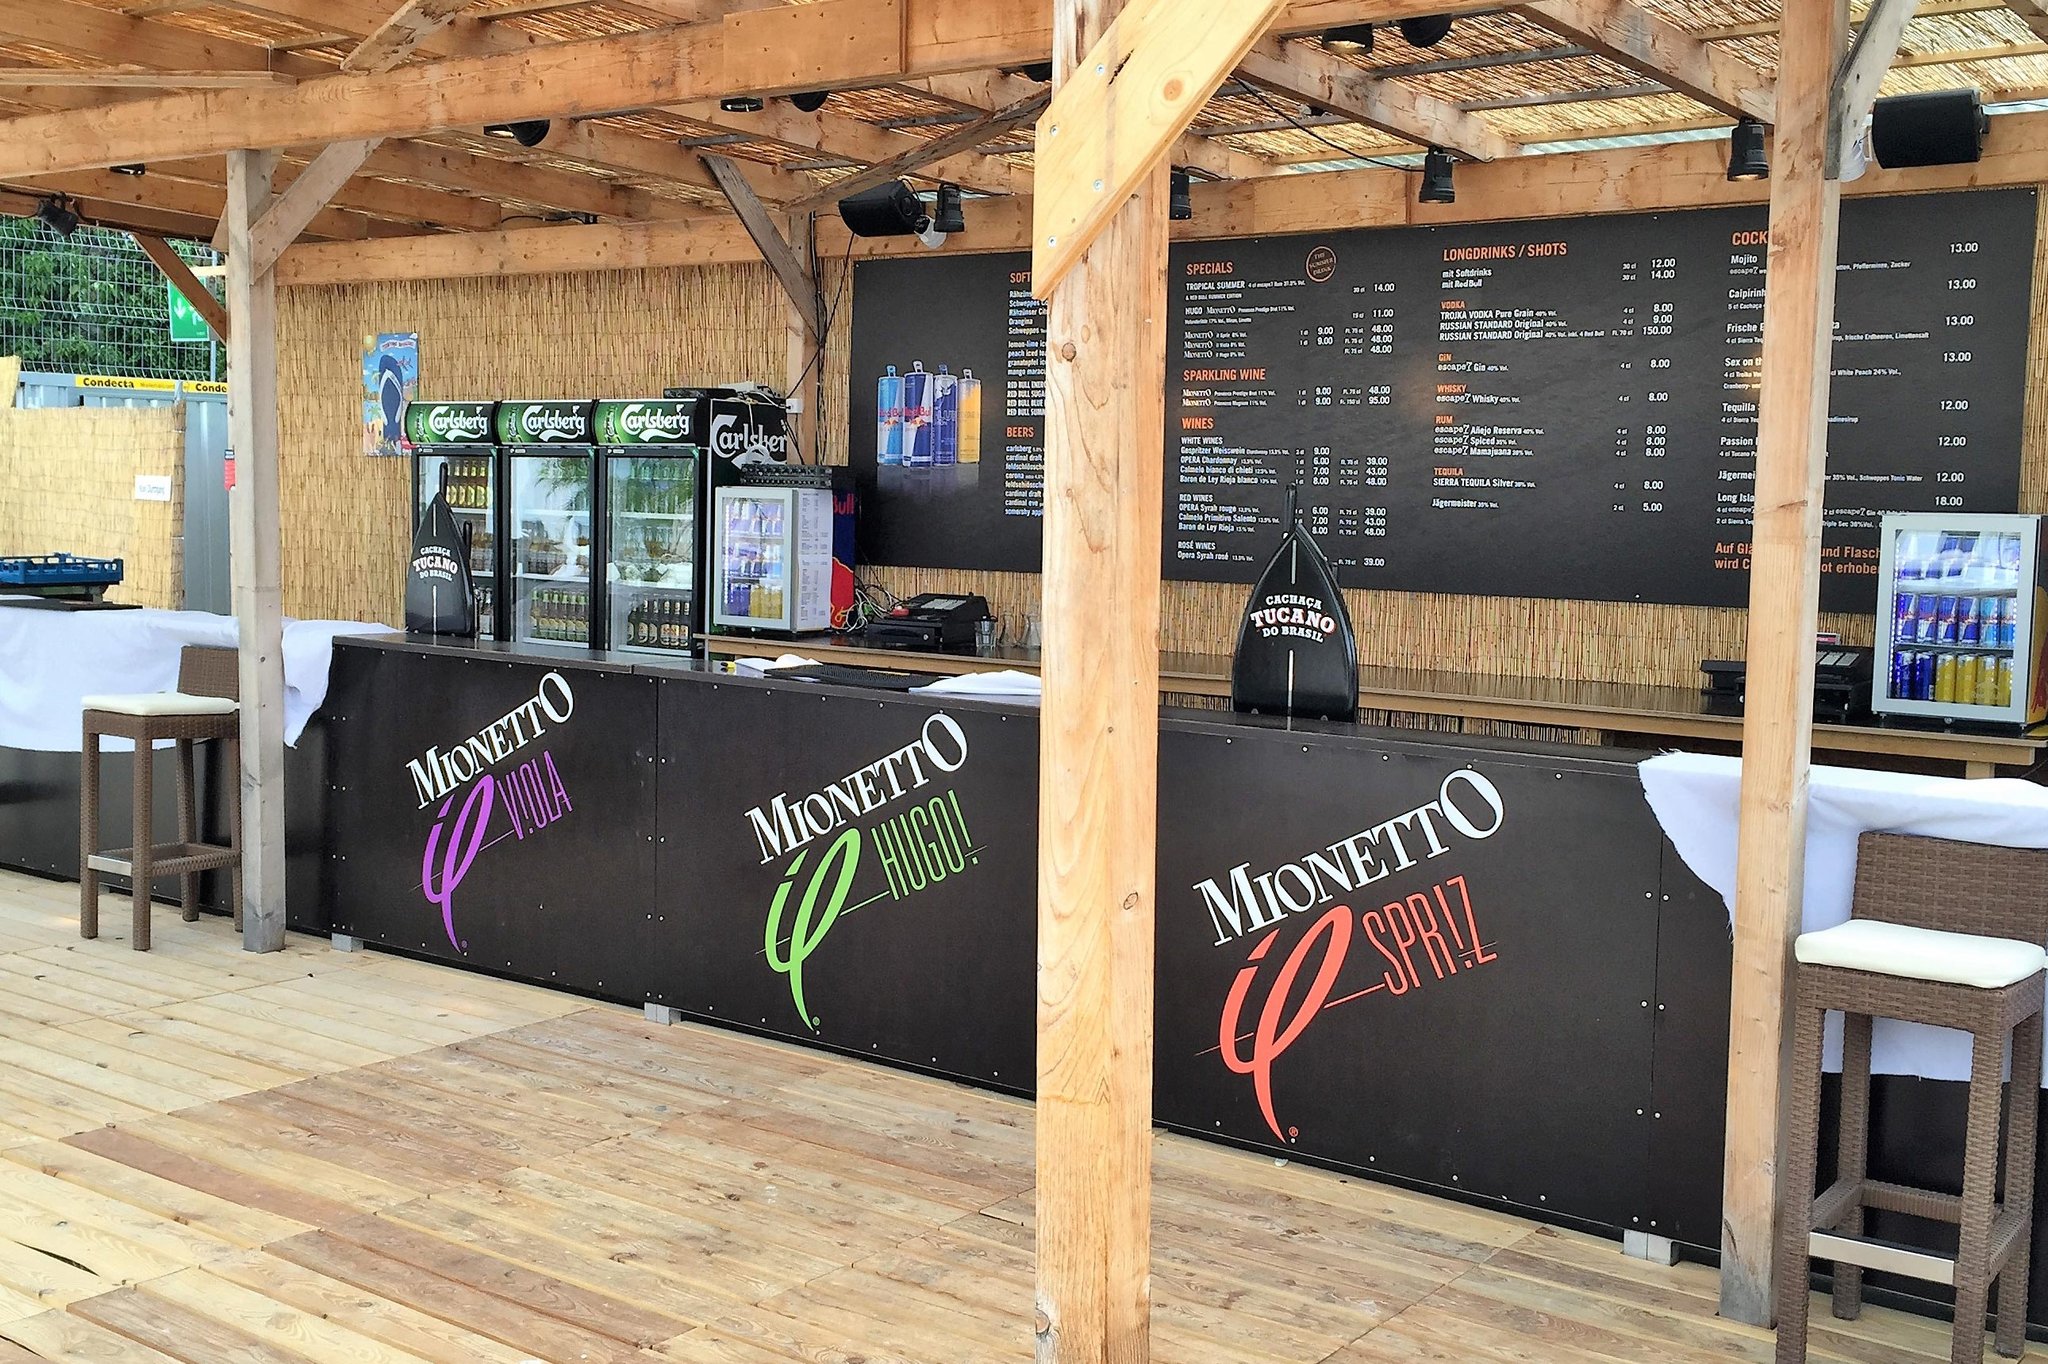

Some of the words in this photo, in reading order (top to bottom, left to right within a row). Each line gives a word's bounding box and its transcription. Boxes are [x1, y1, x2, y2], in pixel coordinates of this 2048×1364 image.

[1732, 232, 1768, 246] COCK
[1443, 245, 1516, 262] LONGDRINKS
[1527, 243, 1567, 257] SHOTS
[1731, 255, 1757, 265] Mojito
[1949, 242, 1979, 253] 13.00
[1186, 262, 1233, 275] SPECIALS
[1442, 269, 1454, 278] mit
[1455, 268, 1492, 278] Softdrinks
[1651, 258, 1676, 268] 12.00
[1010, 272, 1031, 283] SOFT
[1442, 280, 1453, 289] mit
[1651, 270, 1675, 279] 14.00
[1186, 282, 1215, 291] TROPICAL
[1217, 280, 1245, 289] SUMMER
[1373, 283, 1395, 292] 14.00
[1947, 279, 1976, 290] 13.00
[1441, 301, 1465, 309] VODKA
[1185, 307, 1202, 315] HUGO
[1373, 309, 1393, 318] 11.00
[1440, 311, 1467, 320] TROJKA
[1469, 310, 1493, 319] VODKA
[1495, 309, 1512, 318] Pure
[1514, 309, 1534, 317] Grain
[1653, 303, 1673, 313] 8.00
[1440, 321, 1472, 330] RUSSIAN
[1474, 320, 1512, 329] STANDARD
[1515, 319, 1543, 330] Original
[1653, 315, 1672, 324] 9.00
[1727, 323, 1757, 333] Frische
[1945, 315, 1974, 326] 13.00
[1318, 327, 1333, 335] 9.00
[1371, 324, 1393, 333] 48.00
[1439, 331, 1471, 341] RUSSIAN
[1473, 331, 1512, 340] STANDARD
[1514, 330, 1543, 340] Original
[1642, 326, 1672, 335] 150.00
[1317, 336, 1333, 345] 9.00
[1371, 334, 1393, 343] 48.00
[1370, 345, 1392, 354] 48.00
[1474, 363, 1485, 371] Gin
[1650, 359, 1670, 368] 8.00
[1725, 358, 1741, 367] Sex
[1943, 352, 1971, 362] 13.00
[1183, 369, 1236, 382] SPARKLING
[1239, 368, 1266, 380] WINE
[83, 377, 134, 388] Condecta
[1315, 386, 1332, 395] 9.00
[1368, 386, 1391, 395] 48.00
[1437, 384, 1467, 393] WHISKY
[1315, 396, 1331, 405] 9.00
[1368, 396, 1390, 405] 95.00
[1472, 394, 1498, 405] Whisky
[1648, 392, 1668, 402] 8.00
[1722, 403, 1755, 414] Tequilla
[1940, 401, 1969, 411] 12.00
[429, 406, 488, 441] Carlsberg
[522, 405, 585, 441] Carlsberg
[620, 404, 690, 442] Carlsberg
[1182, 418, 1213, 430] WINES
[1435, 416, 1453, 424] RUM
[1007, 427, 1034, 437] BEERS
[1646, 425, 1667, 435] 8.00
[1181, 437, 1201, 445] WHITE
[1202, 437, 1223, 445] WINES
[1470, 436, 1495, 446] Spiced
[1646, 437, 1666, 446] 8.00
[1720, 436, 1753, 446] Passion
[1938, 437, 1966, 447] 12.00
[1314, 447, 1329, 455] 9.00
[1646, 448, 1665, 457] 8.00
[1313, 457, 1329, 466] 6.00
[1366, 457, 1388, 466] 39.00
[1313, 467, 1329, 476] 7.00
[1366, 467, 1387, 476] 43.00
[1434, 468, 1464, 477] TEQUILA
[1312, 477, 1329, 486] 8.00
[1365, 477, 1387, 486] 48.00
[1936, 473, 1964, 482] 12.00
[1433, 478, 1459, 487] SIERRA
[1461, 478, 1491, 488] TEQUILA
[1492, 479, 1514, 488] Silver
[1644, 481, 1664, 490] 8.00
[1179, 494, 1191, 502] RED
[1193, 494, 1213, 502] WINES
[1718, 493, 1737, 504] Long
[1935, 496, 1963, 506] 18.00
[1179, 504, 1198, 512] OPERA
[1312, 506, 1328, 515] 6.00
[1365, 507, 1386, 516] 39.00
[1432, 499, 1477, 510] Jägermeister
[1643, 503, 1663, 512] 5.00
[1312, 516, 1328, 525] 7.00
[1364, 517, 1386, 526] 43.00
[1312, 526, 1328, 535] 8.00
[1364, 528, 1385, 536] 48.00
[1195, 542, 1216, 550] WINES
[1715, 543, 1734, 554] Auf
[412, 556, 458, 574] TUCANO
[1363, 558, 1384, 567] 39.00
[1715, 559, 1738, 569] wird
[420, 570, 428, 579] DO
[430, 570, 452, 582] BRASIL
[1265, 594, 1322, 610] CACHAÇA
[1250, 607, 1336, 634] TUCANO
[1262, 627, 1278, 638] DO
[1282, 626, 1324, 643] BRASIL
[871, 789, 979, 901] HUGO!
